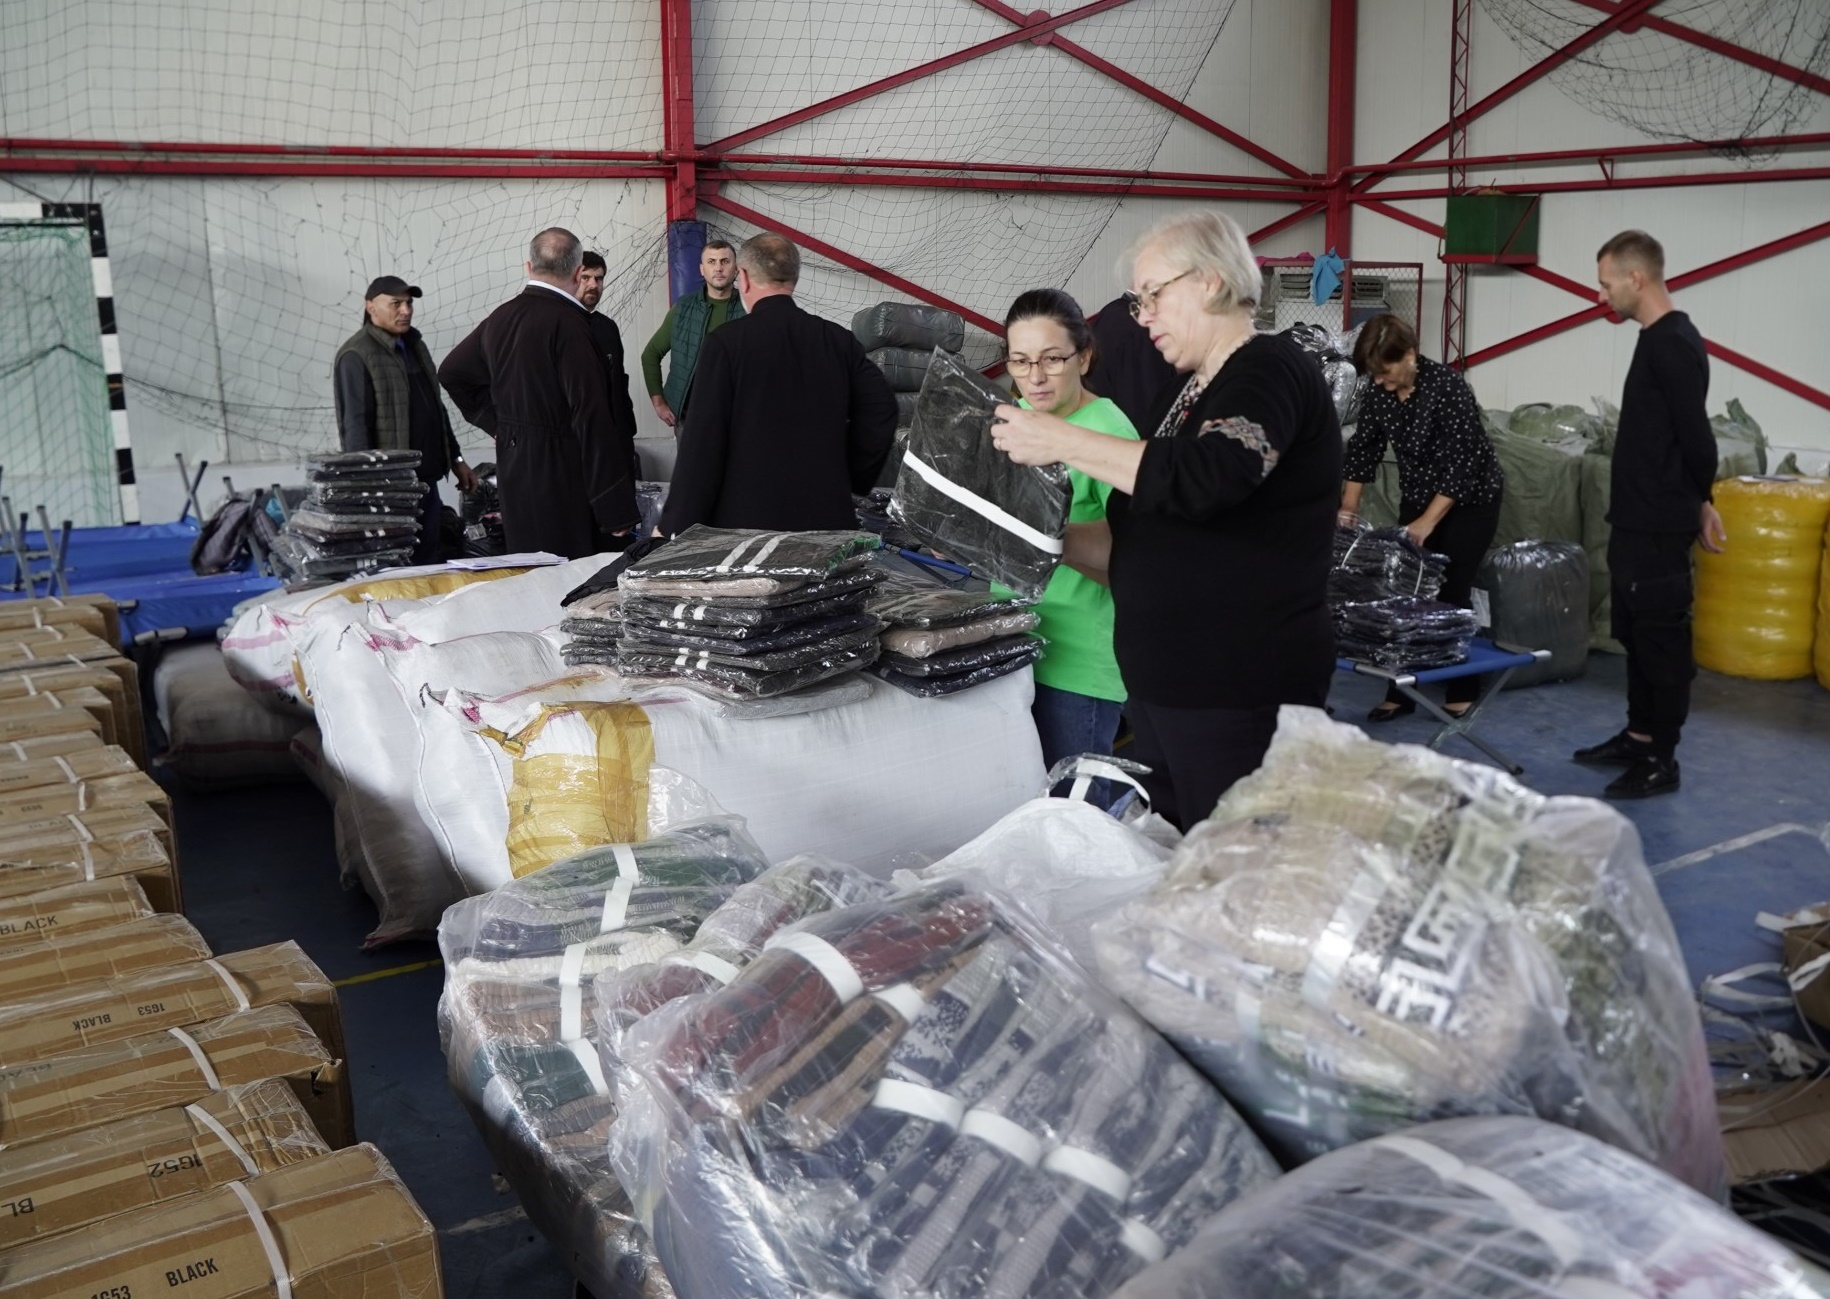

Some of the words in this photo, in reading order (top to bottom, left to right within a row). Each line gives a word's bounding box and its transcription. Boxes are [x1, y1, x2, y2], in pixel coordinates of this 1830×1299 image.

[0, 915, 58, 935] BLACK
[137, 1003, 166, 1016] 1G53
[72, 1013, 112, 1031] BLACK
[147, 1153, 203, 1178] 1G52
[165, 1257, 219, 1288] BLACK
